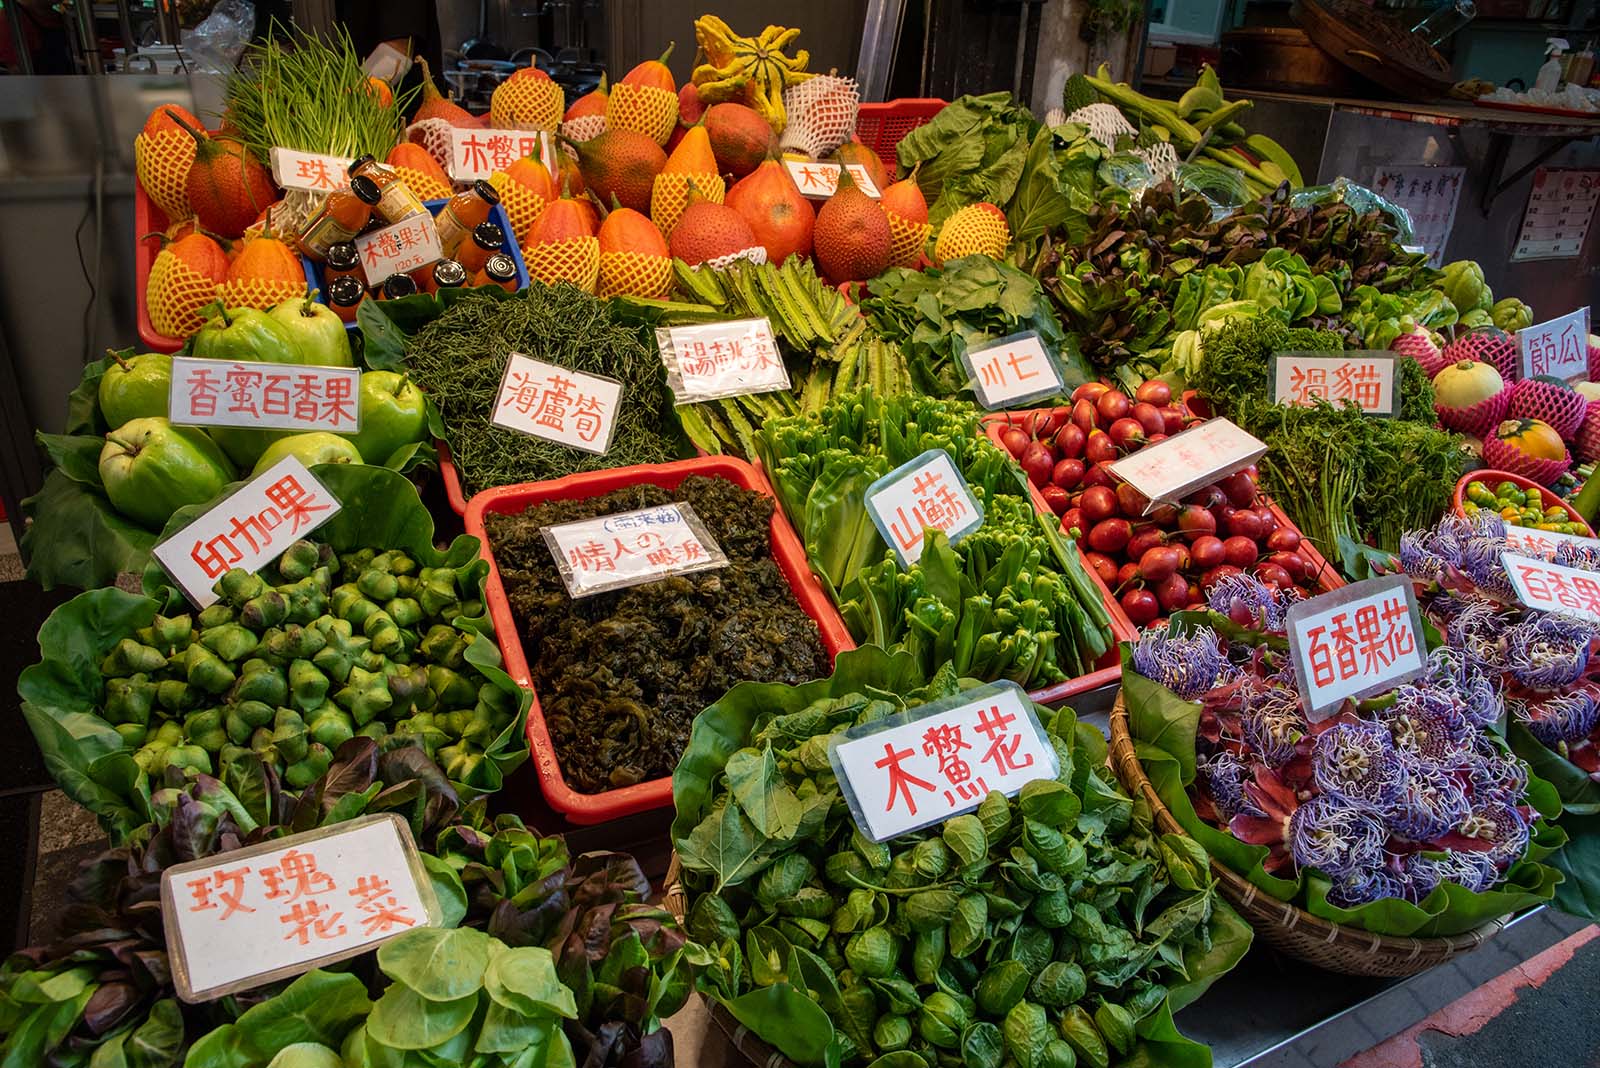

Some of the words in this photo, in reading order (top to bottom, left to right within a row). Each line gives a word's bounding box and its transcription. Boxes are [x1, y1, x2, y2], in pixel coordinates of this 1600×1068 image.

[981, 352, 1039, 387] 川七
[1528, 324, 1582, 376] 節瓜
[186, 364, 356, 426] 香蜜百香果
[506, 372, 606, 442] 海蘆筍
[1290, 362, 1381, 409] 過貓
[191, 474, 331, 579] 印加果
[1307, 597, 1414, 689] 百香果花
[186, 849, 337, 921] 玫瑰
